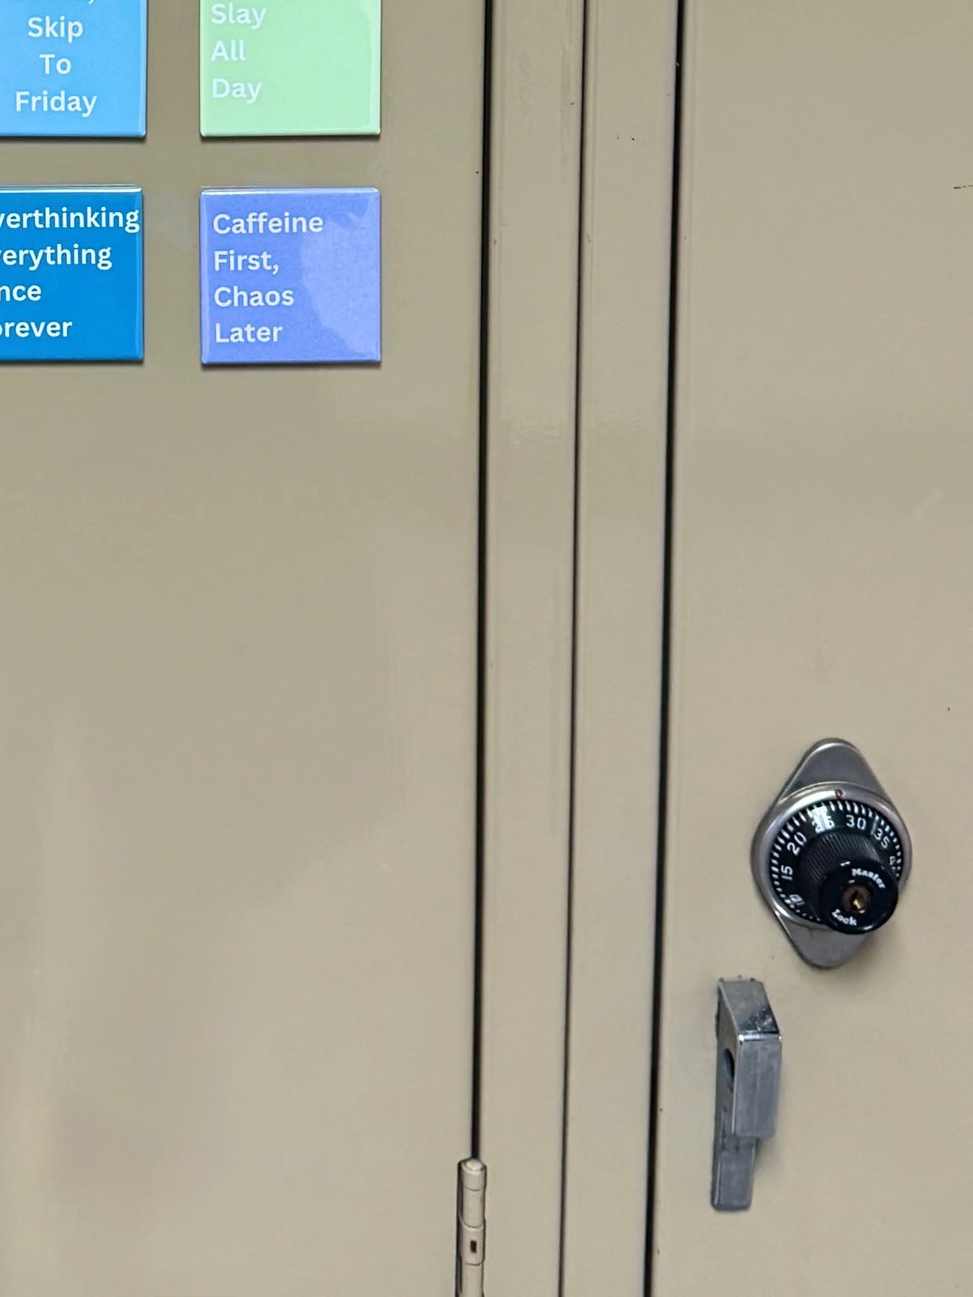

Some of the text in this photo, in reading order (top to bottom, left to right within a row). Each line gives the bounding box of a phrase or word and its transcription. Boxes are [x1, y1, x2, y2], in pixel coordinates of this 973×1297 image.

[211, 3, 266, 29] Slay
[28, 16, 83, 43] Skip
[211, 40, 245, 61] All
[40, 54, 71, 74] To
[213, 78, 262, 103] Day
[16, 90, 96, 117] Friday
[214, 212, 323, 234] Caffeine
[215, 250, 278, 274] First,
[215, 286, 294, 307] Chaos
[216, 323, 282, 342] Later
[846, 815, 866, 830] 30
[787, 832, 807, 855] 20
[874, 828, 889, 849] 35
[780, 865, 793, 880] 15
[851, 868, 886, 889] Master
[831, 909, 858, 926] Lock
